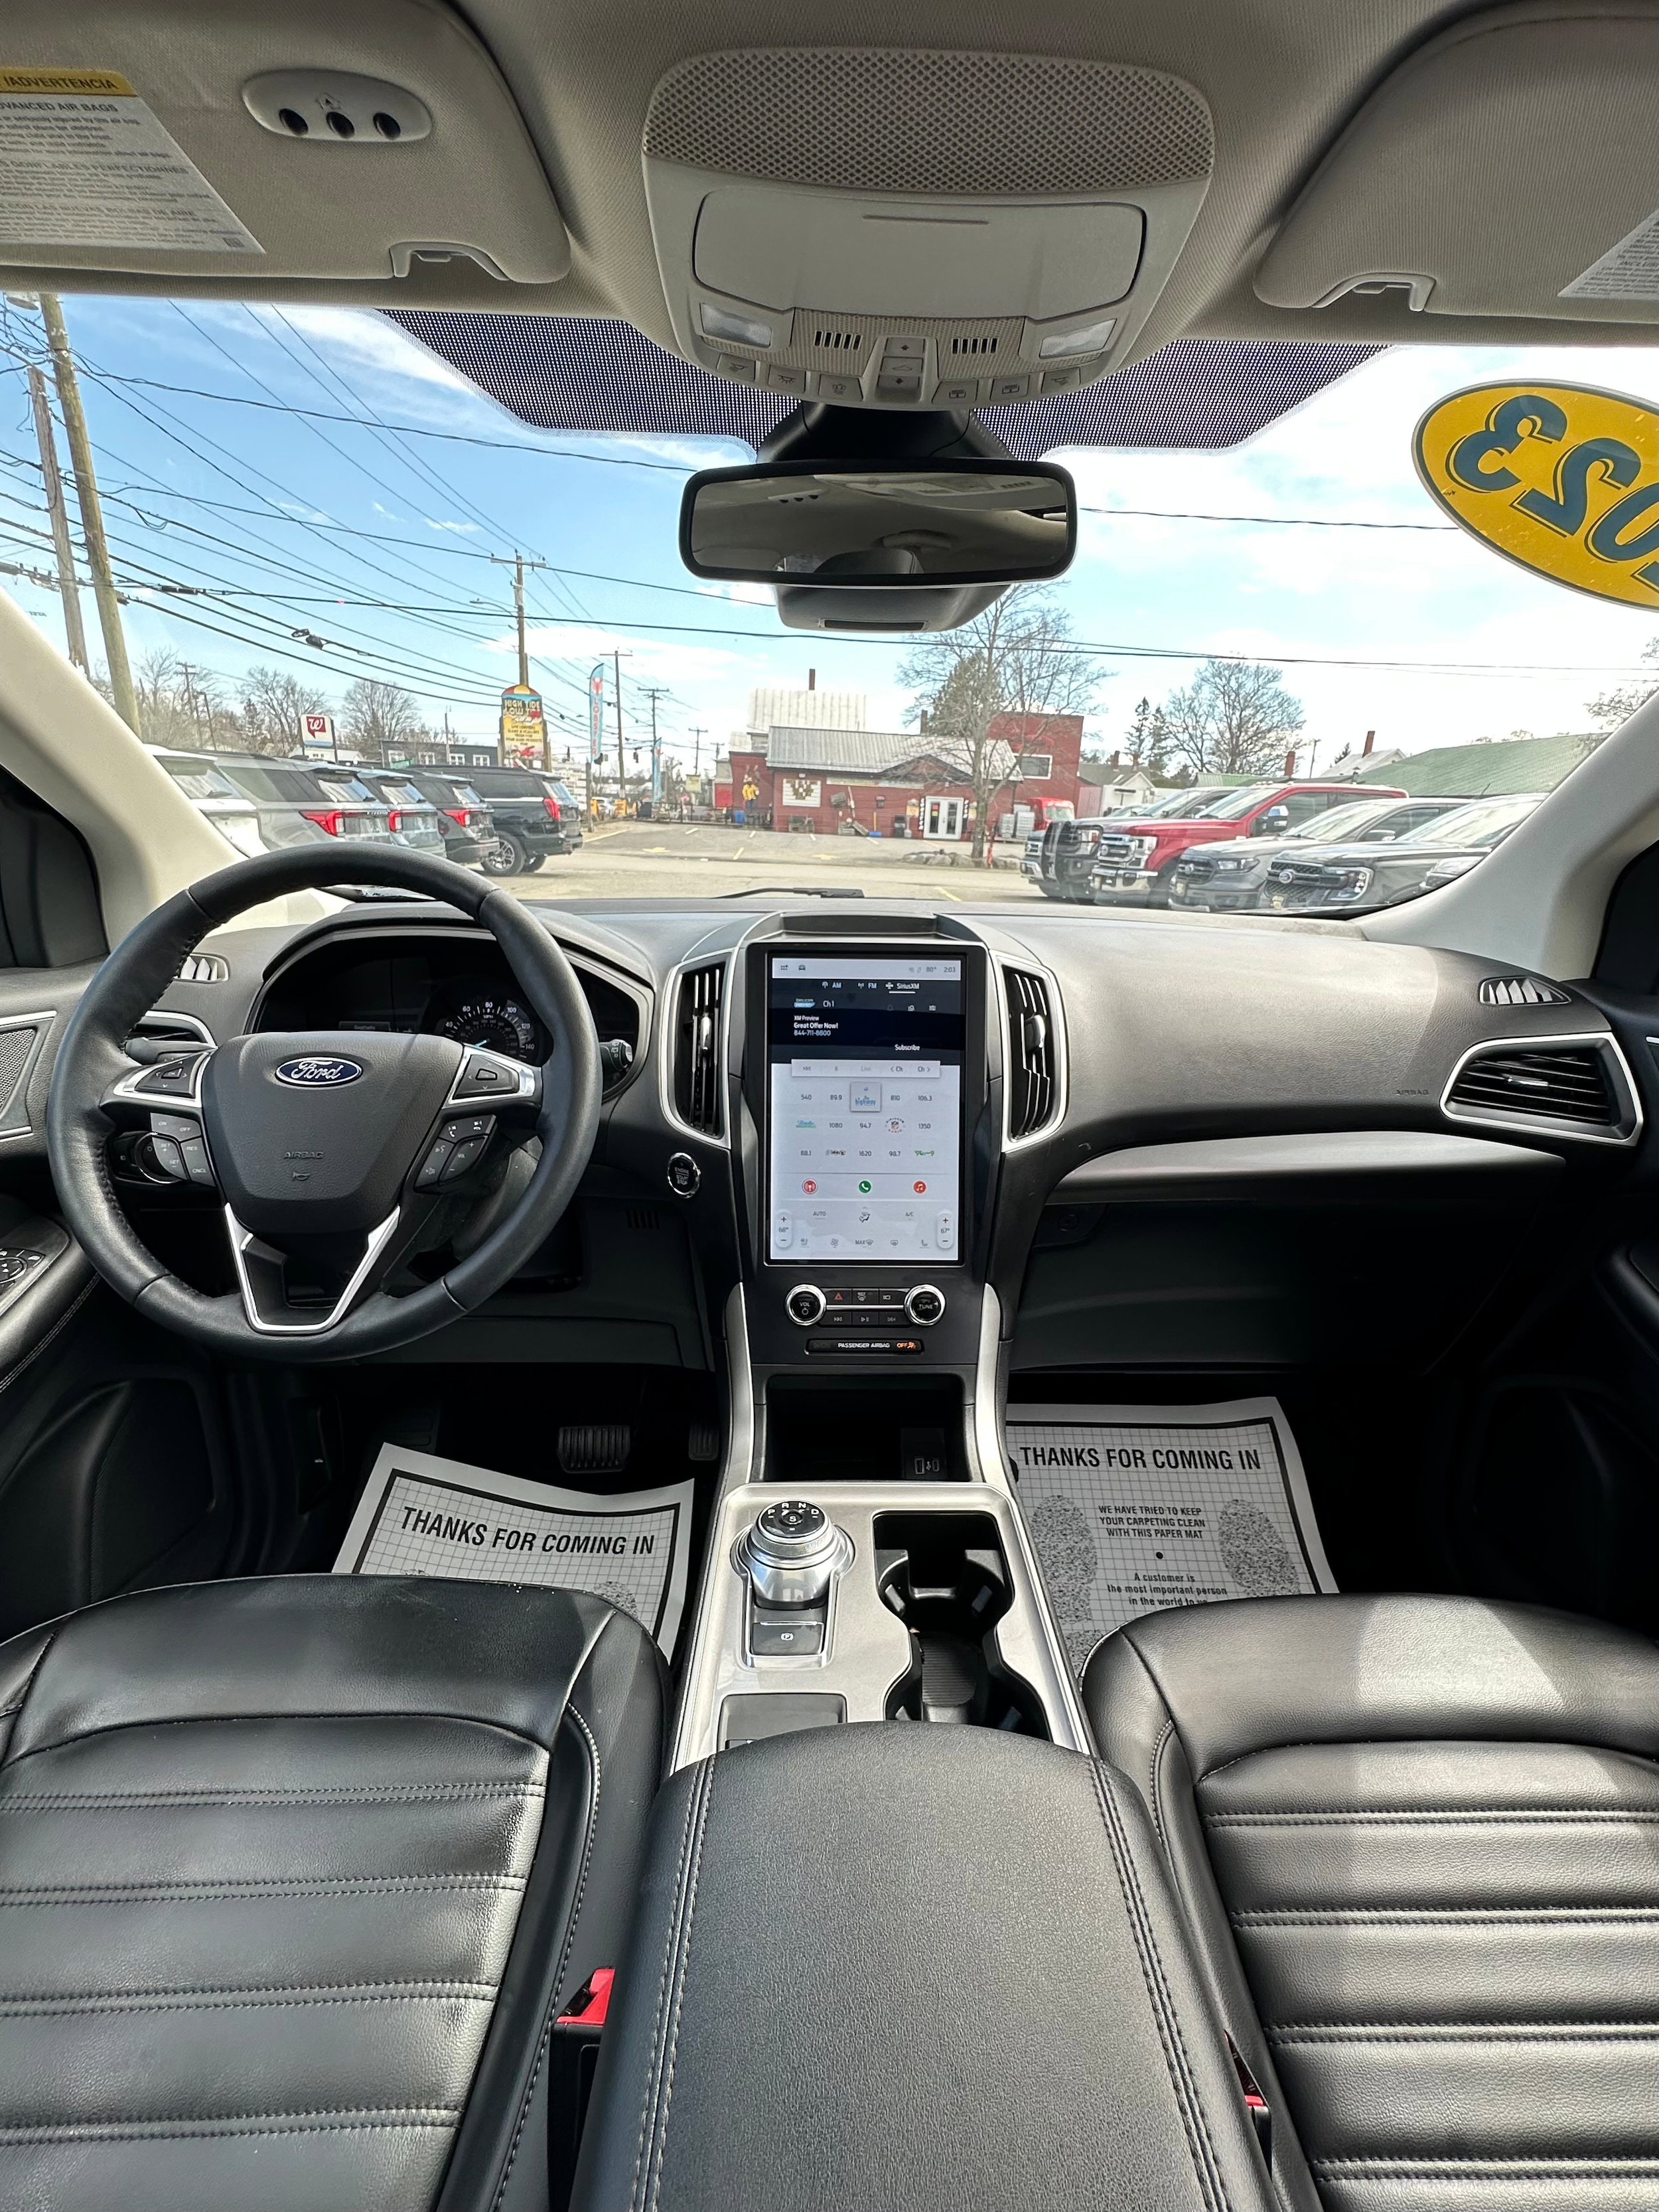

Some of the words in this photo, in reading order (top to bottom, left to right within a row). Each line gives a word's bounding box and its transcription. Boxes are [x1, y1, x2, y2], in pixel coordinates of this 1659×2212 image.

[56, 102, 80, 111] AIR
[80, 103, 119, 113] BAGS
[525, 700, 540, 709] TIDE
[291, 1061, 344, 1080] Ford
[855, 1098, 876, 1106] highway
[284, 1151, 325, 1159] AIRBAG
[1019, 1446, 1101, 1467] THANKS
[1106, 1448, 1148, 1469] FOR
[1153, 1449, 1234, 1470] COMING
[1239, 1449, 1262, 1470] IN
[1098, 1505, 1113, 1514] WE
[1114, 1506, 1137, 1514] HAVE
[1138, 1506, 1165, 1515] TRIED
[1167, 1507, 1178, 1515] TO
[1180, 1507, 1202, 1516] KEEP
[1099, 1516, 1125, 1525] YOUR
[1126, 1517, 1175, 1526] CARPETING
[1177, 1518, 1206, 1527] CLEAN
[401, 1506, 488, 1546] THANKS
[492, 1528, 538, 1552] FOR
[541, 1534, 627, 1555] COMING
[632, 1534, 656, 1555] IN
[1106, 1528, 1130, 1537] WITH
[1131, 1528, 1152, 1537] THIS
[1154, 1529, 1183, 1538] PAPER
[1185, 1530, 1202, 1539] MAT
[1134, 1572, 1141, 1581] A
[1107, 1584, 1122, 1593] the
[1125, 1585, 1147, 1593] most
[1149, 1585, 1194, 1595] important
[1196, 1587, 1228, 1596] person
[1128, 1597, 1138, 1605] in
[1157, 1597, 1183, 1607] world
